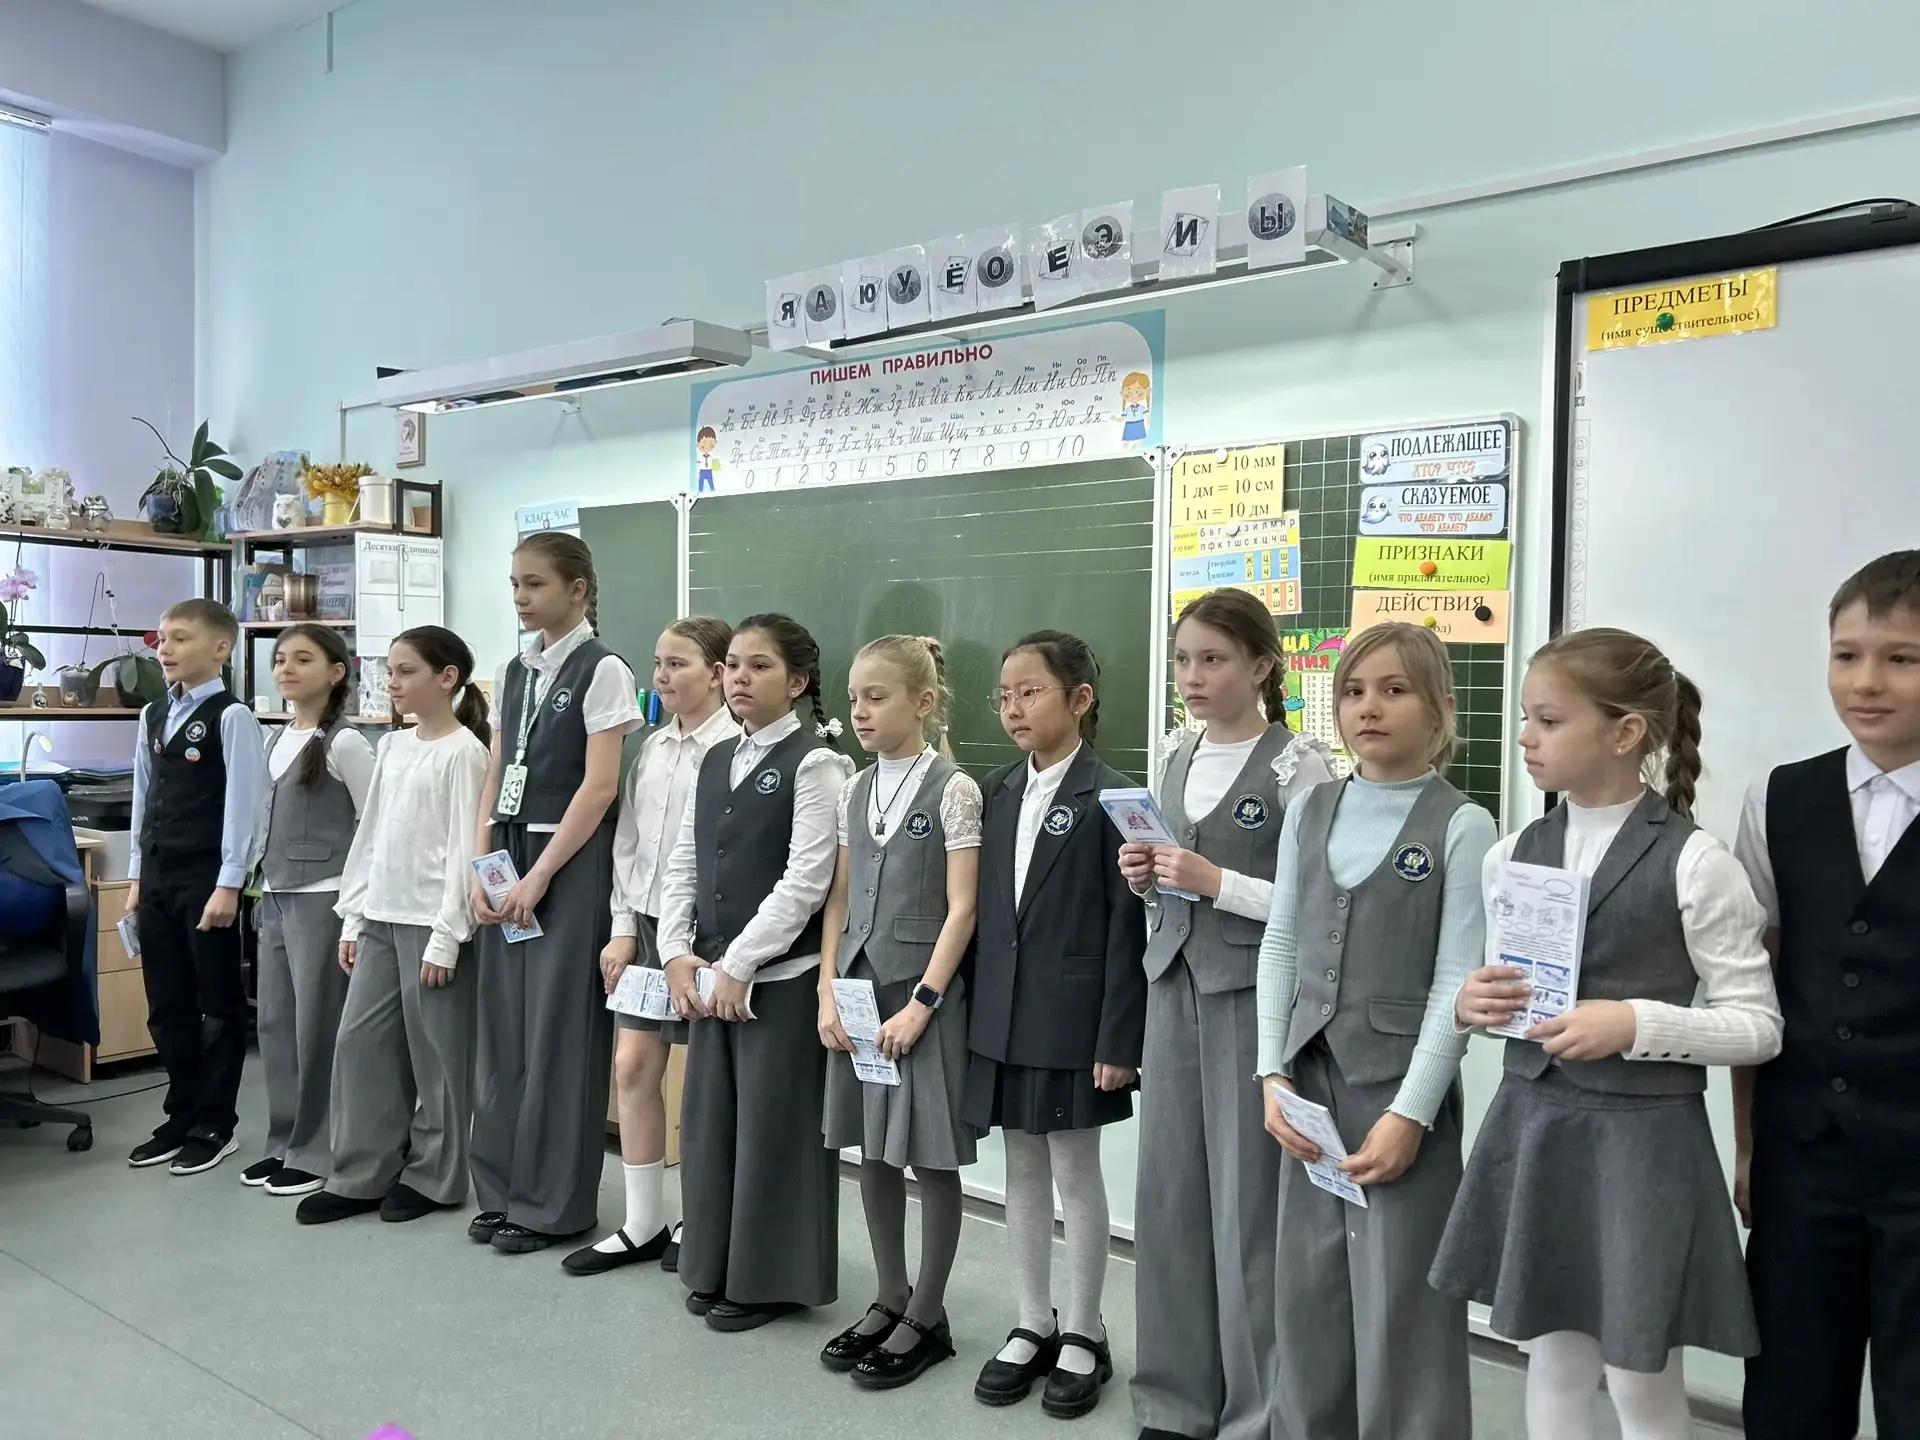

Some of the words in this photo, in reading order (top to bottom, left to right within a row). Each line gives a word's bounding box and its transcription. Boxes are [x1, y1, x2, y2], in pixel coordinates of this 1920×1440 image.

[780, 299, 794, 320] Я
[814, 292, 830, 313] А
[858, 284, 875, 305] Ю
[896, 269, 913, 296] У
[946, 261, 964, 287] Ё
[986, 256, 1005, 280] О
[1047, 247, 1069, 271] Е
[1094, 224, 1112, 250] Э
[1176, 220, 1198, 247] И
[1260, 204, 1284, 235] Ы
[1613, 279, 1748, 316] ПРЕДМЕТЫ
[1601, 329, 1632, 343] (имя
[1636, 308, 1760, 339] сущствительное)
[810, 363, 871, 386] ПИШЕМ
[882, 344, 992, 374] ПРАВИЛЬНО
[1070, 368, 1087, 387] Оо
[1091, 362, 1117, 384] Пп
[1391, 429, 1502, 457] ПОДЛЕЖАЩЕЕ
[744, 470, 754, 488] 0
[773, 466, 782, 486] 1
[798, 464, 809, 485] 2
[826, 461, 837, 482] 3
[858, 458, 867, 478] 4
[885, 455, 897, 476] 5
[917, 452, 928, 472] 6
[950, 448, 960, 469] 7
[983, 444, 994, 466] 8
[1018, 441, 1030, 463] 9
[1058, 435, 1084, 459] 10
[1182, 462, 1186, 476] 1
[1193, 463, 1212, 474] см
[1234, 455, 1249, 471] 10
[1254, 456, 1275, 468] мм
[1183, 485, 1186, 498] 1
[1193, 486, 1213, 499] дм
[1236, 478, 1250, 494] 10
[1256, 480, 1274, 491] см
[1402, 486, 1491, 505] СКАЗУЕМОЕ
[1186, 507, 1190, 521] 1
[1197, 510, 1207, 520] м
[1229, 502, 1245, 518] 10
[1249, 504, 1269, 517] дм
[1378, 546, 1484, 560] ПРИЗНАКИ
[1369, 572, 1393, 583] (имя
[1398, 574, 1490, 585] прилагательное)
[1376, 593, 1484, 614] ДЕЙСТВИЯ
